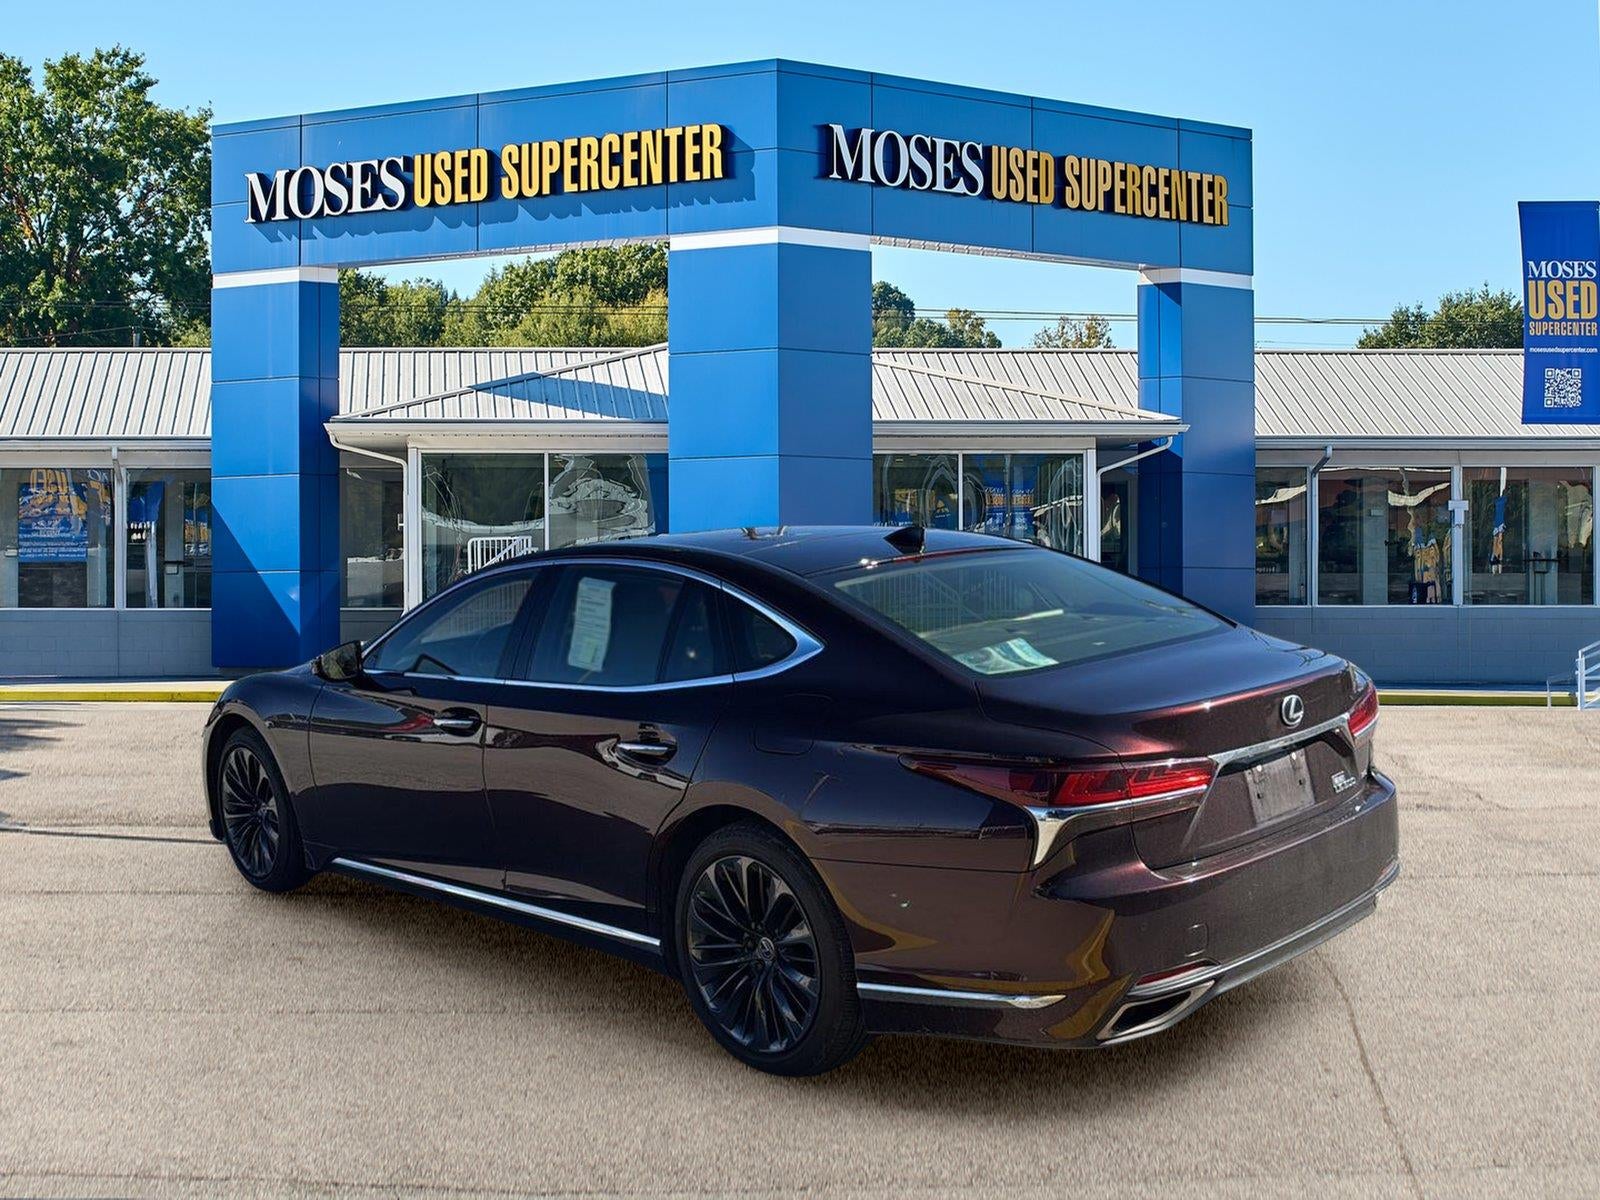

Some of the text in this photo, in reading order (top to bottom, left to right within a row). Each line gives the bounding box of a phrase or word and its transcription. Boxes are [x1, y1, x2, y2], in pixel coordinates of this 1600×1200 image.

[244, 123, 724, 224] MOSES USED SUPERCENTER
[828, 123, 1229, 227] MOSES USED SUPERCENTER
[1527, 260, 1597, 278] MOSES
[1528, 280, 1597, 319] USED
[1529, 322, 1598, 336] SUPERCENTER
